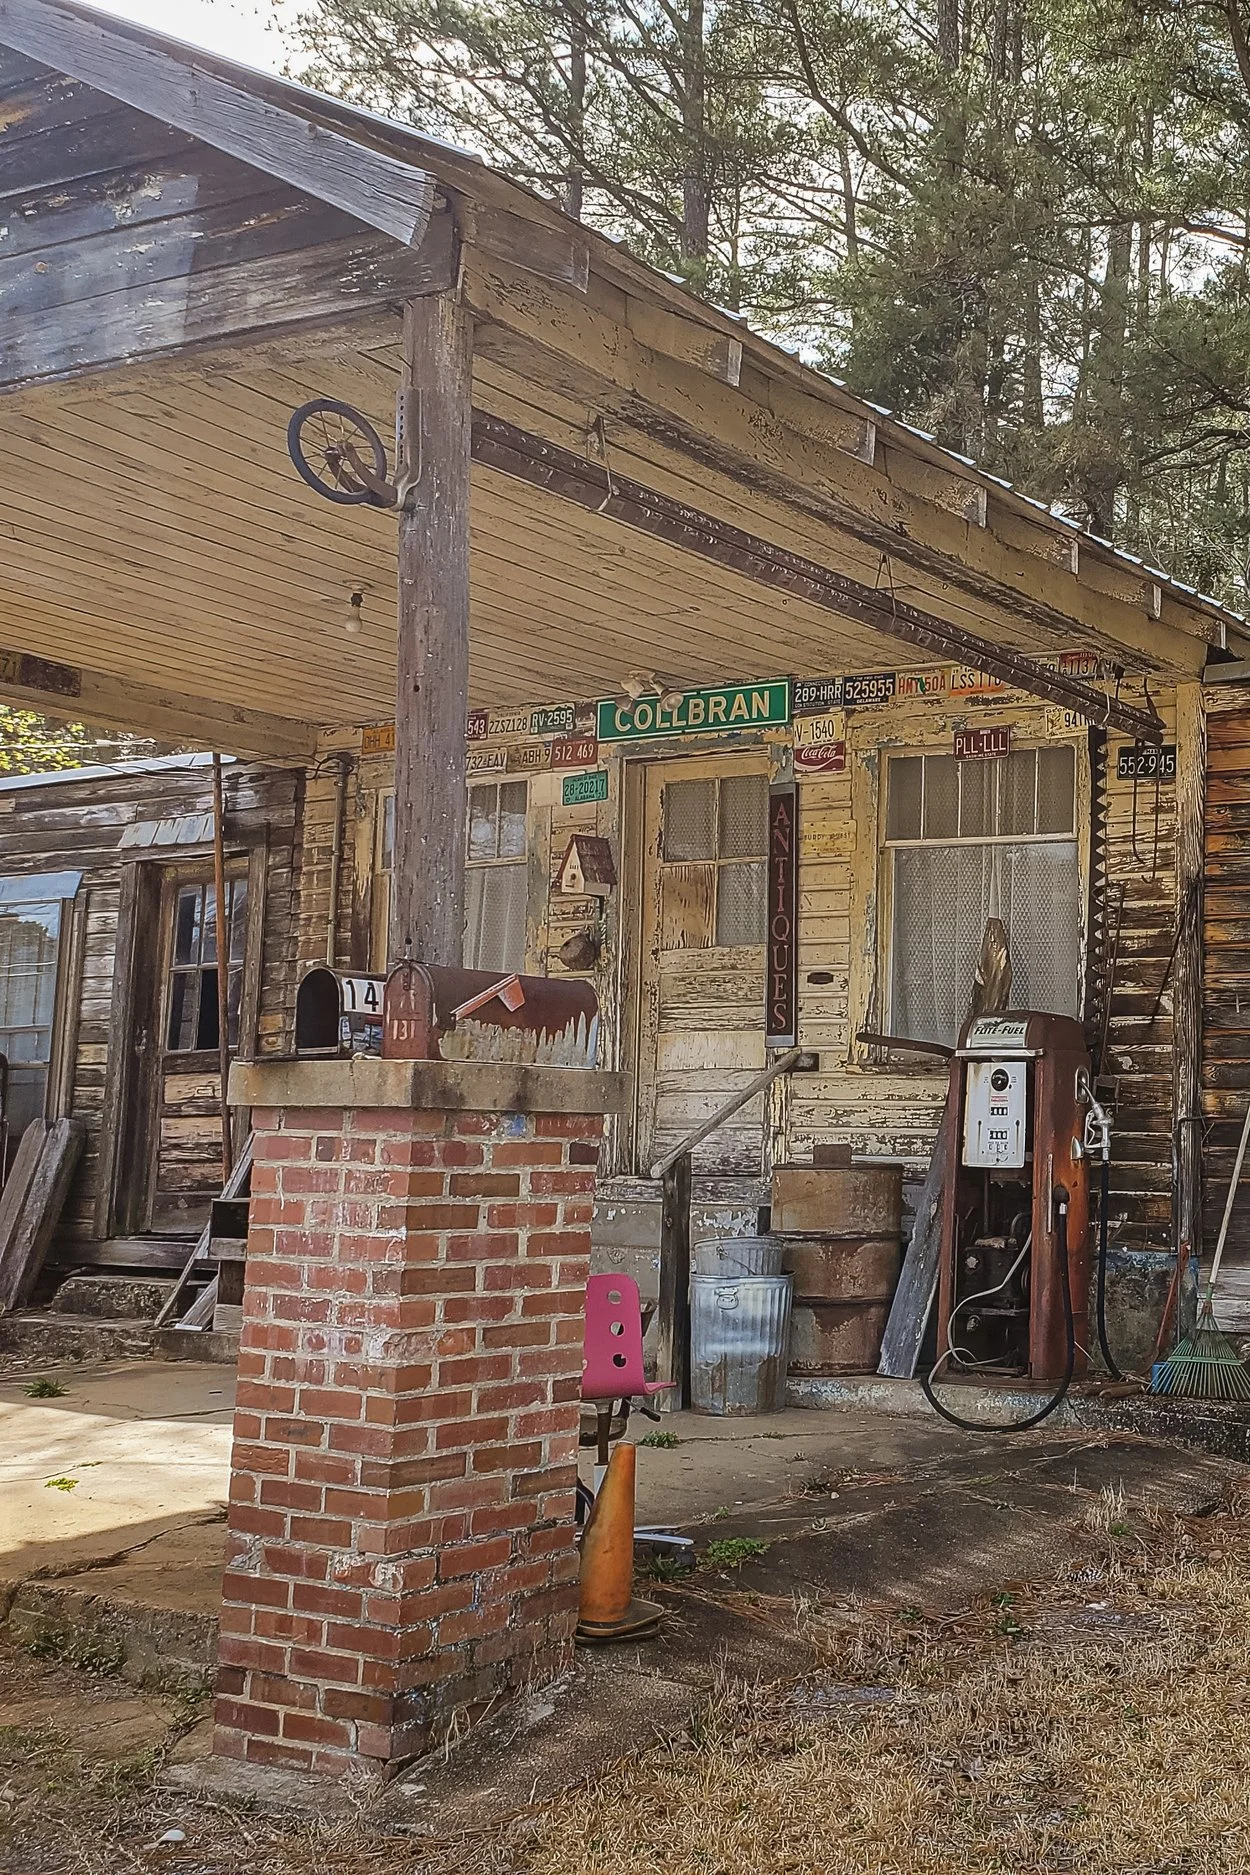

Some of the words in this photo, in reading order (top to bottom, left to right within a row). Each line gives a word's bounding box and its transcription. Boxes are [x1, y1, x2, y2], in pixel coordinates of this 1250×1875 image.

[846, 679, 894, 699] 525955
[952, 673, 975, 690] LSS
[468, 720, 486, 735] 543
[522, 749, 541, 764] ABH
[555, 745, 573, 760] 512
[577, 743, 594, 759] 469
[565, 779, 605, 797] 28-20217
[771, 801, 791, 1030] ANTIQUES
[974, 1025, 1025, 1035] FLITE-FUEL
